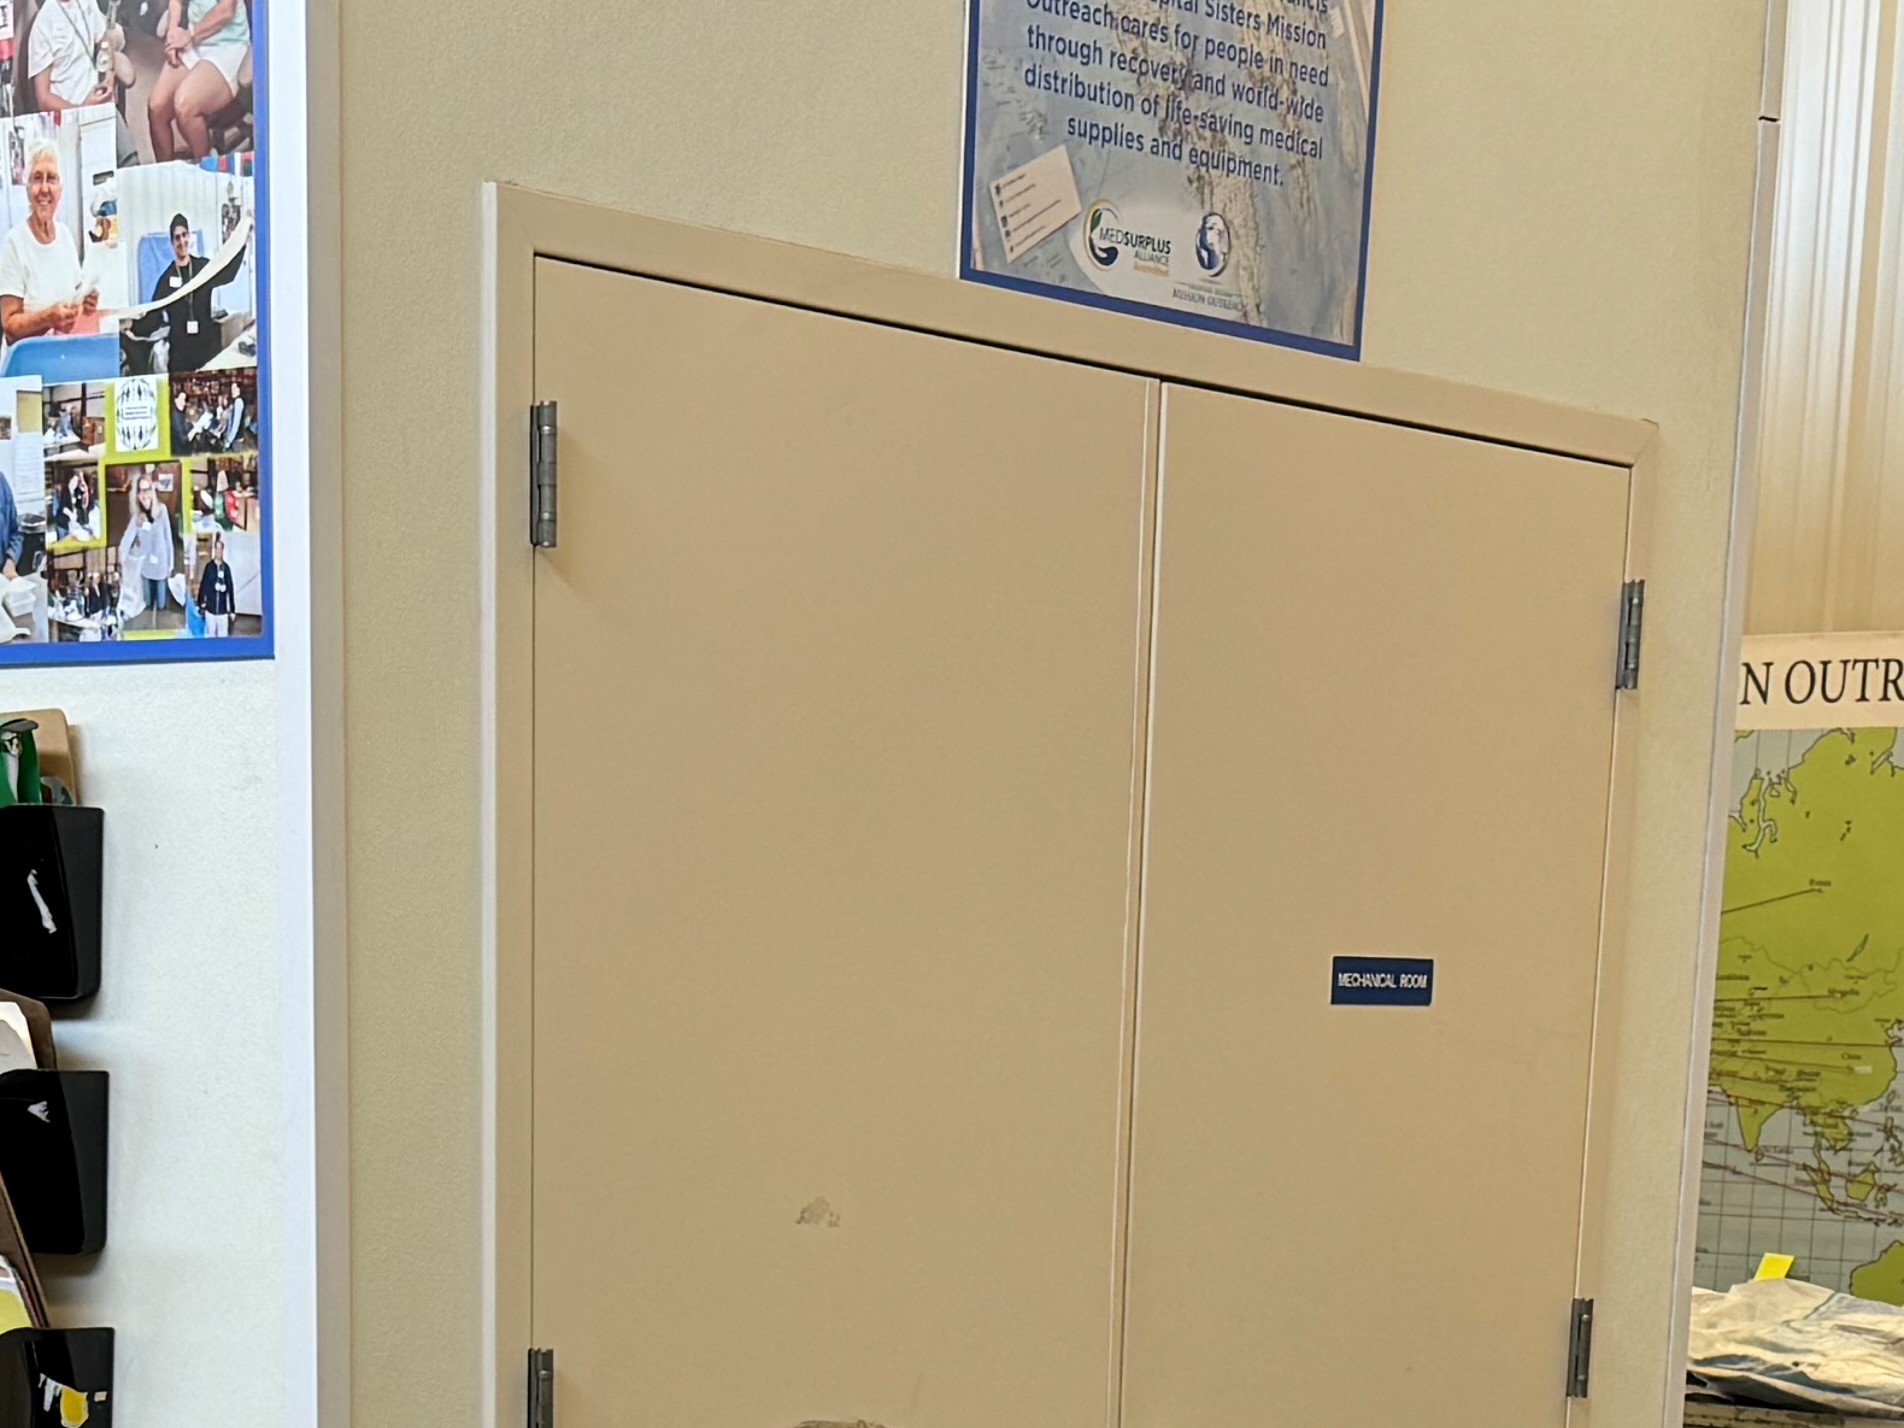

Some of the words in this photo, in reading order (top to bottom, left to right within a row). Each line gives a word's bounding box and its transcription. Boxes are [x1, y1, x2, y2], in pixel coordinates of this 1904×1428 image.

[1027, 0, 1114, 29] Outreach
[1121, 14, 1169, 43] cares
[1173, 24, 1199, 50] for
[1204, 36, 1264, 70] people
[1269, 50, 1284, 74] in
[1289, 60, 1330, 87] need
[1205, 0, 1262, 31] Sisters
[1266, 12, 1327, 49] Mission
[1027, 24, 1103, 65] through
[1109, 48, 1189, 90] recovery
[1194, 67, 1226, 96] and
[1231, 78, 1325, 123] world-wide
[1024, 64, 1134, 112] distribution
[1140, 92, 1160, 117] of
[1164, 97, 1254, 144] life-saving
[1259, 128, 1324, 160] medical
[1067, 114, 1144, 152] supplies
[1149, 133, 1183, 162] and
[1188, 146, 1285, 186] equipment.
[1099, 227, 1171, 254] MEDSURPLUS
[1338, 972, 1397, 988] MECHANICAL
[1399, 973, 1428, 988] ROOM
